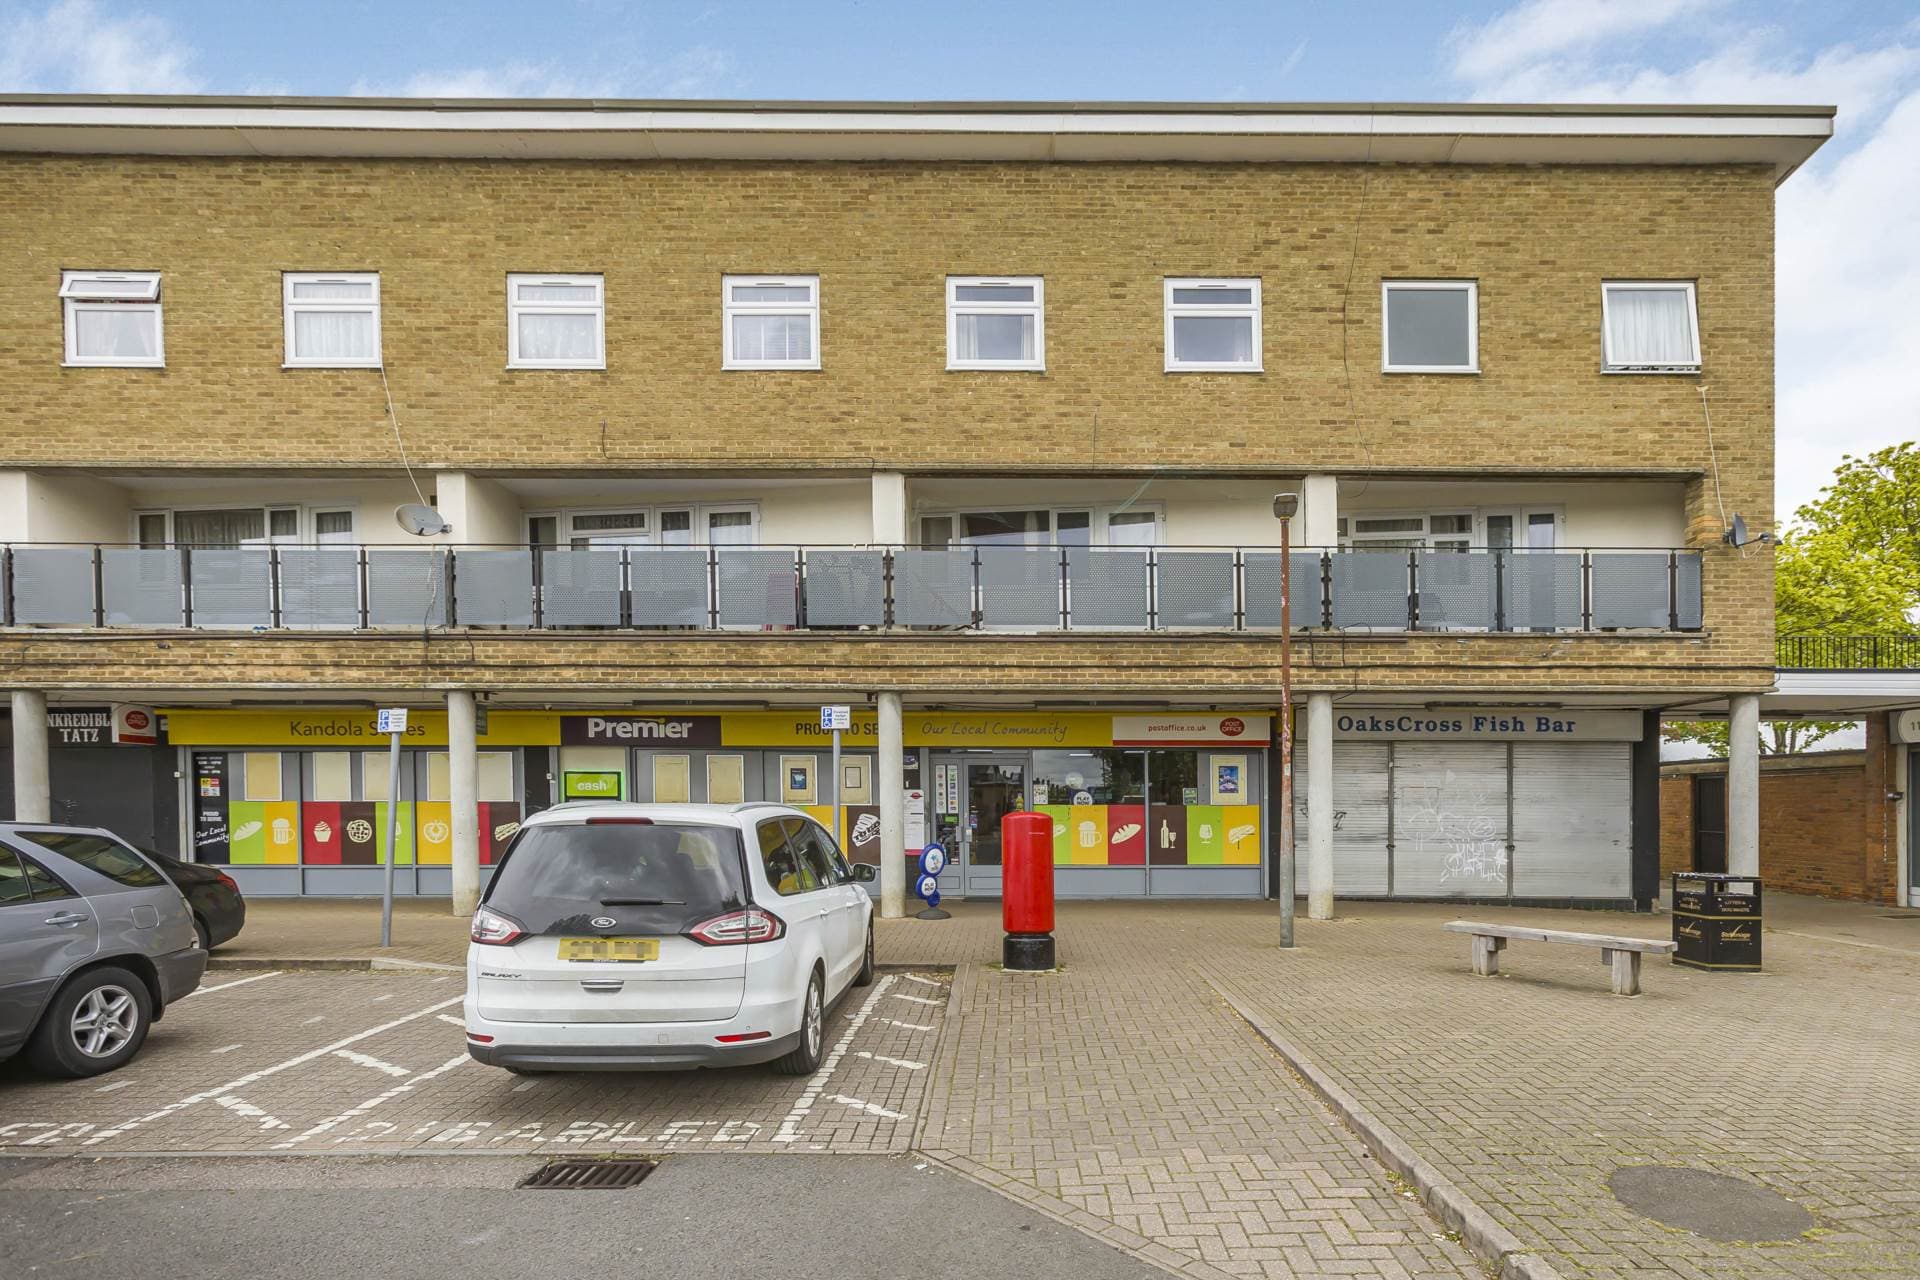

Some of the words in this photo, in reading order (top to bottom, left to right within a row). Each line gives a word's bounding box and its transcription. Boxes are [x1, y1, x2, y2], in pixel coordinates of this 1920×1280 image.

[48, 713, 112, 727] NKREDIBL
[587, 717, 693, 738] Premier
[1337, 716, 1463, 732] OaksCross
[1473, 716, 1526, 732] Fish
[1536, 717, 1576, 732] Bar
[59, 728, 99, 742] TATZ
[290, 720, 363, 736] Kandola
[368, 720, 426, 736] Ses
[922, 721, 946, 734] Our
[952, 721, 987, 735] Local
[992, 721, 1068, 742] Community
[1148, 724, 1206, 732] postoffice.co.uk
[577, 780, 607, 791] cash
